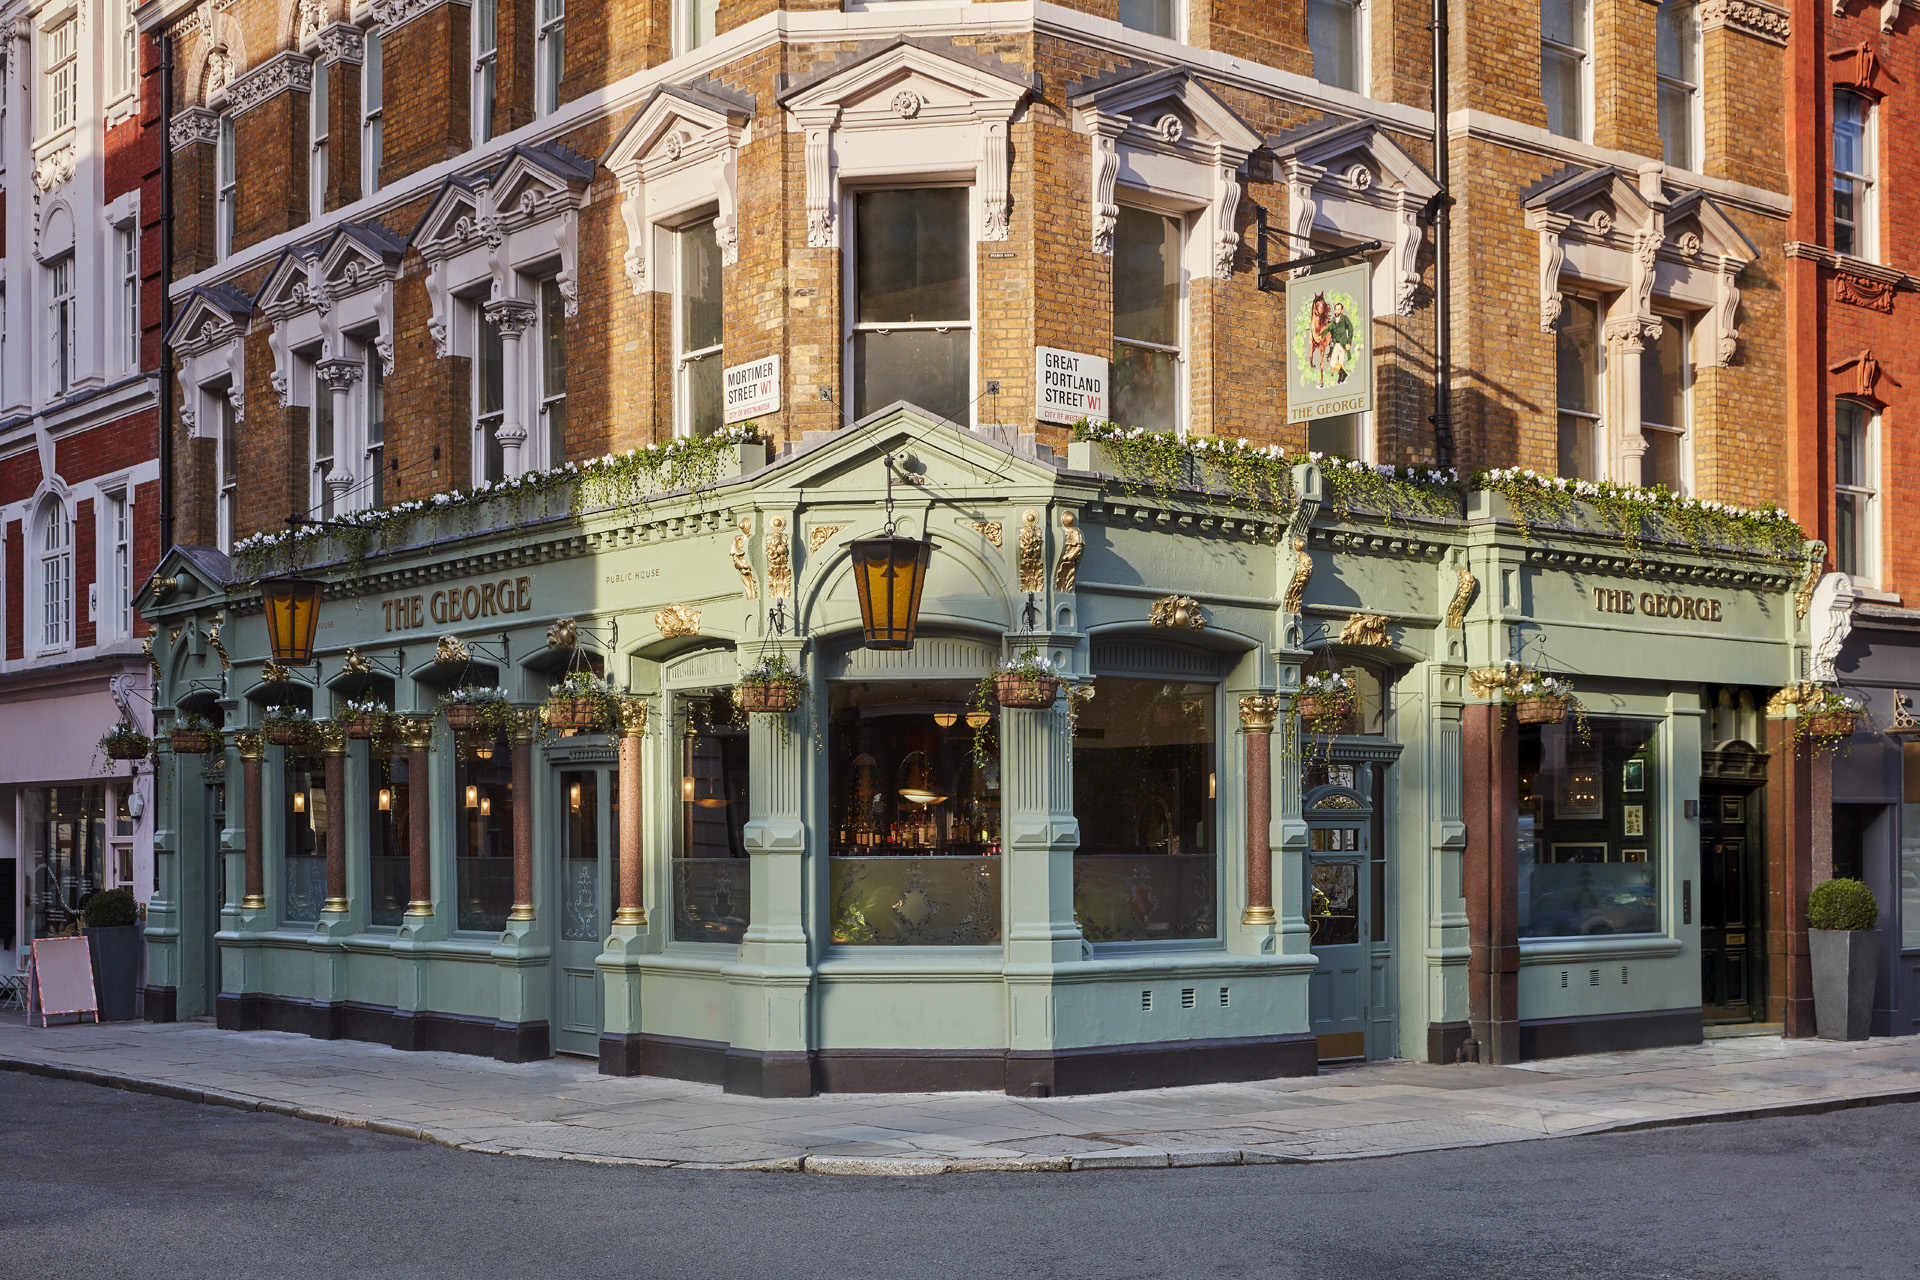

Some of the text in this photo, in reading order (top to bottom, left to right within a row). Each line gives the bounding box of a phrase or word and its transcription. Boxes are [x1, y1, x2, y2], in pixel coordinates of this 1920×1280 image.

[1045, 353, 1079, 372] GREAT
[728, 362, 773, 387] MORTIMER
[1045, 370, 1101, 393] PORTLAND
[728, 380, 772, 404] STREET W1
[1045, 388, 1101, 411] STREET W1
[729, 402, 770, 419] CITY OF WESTMINSTER
[1044, 410, 1056, 419] CITY
[1057, 412, 1064, 420] OF
[1291, 397, 1365, 420] THE GEORGE
[606, 568, 660, 584] PUBLIC HOUSE
[381, 576, 531, 631] THE GEORGE
[1591, 587, 1722, 622] THE GEORGE
